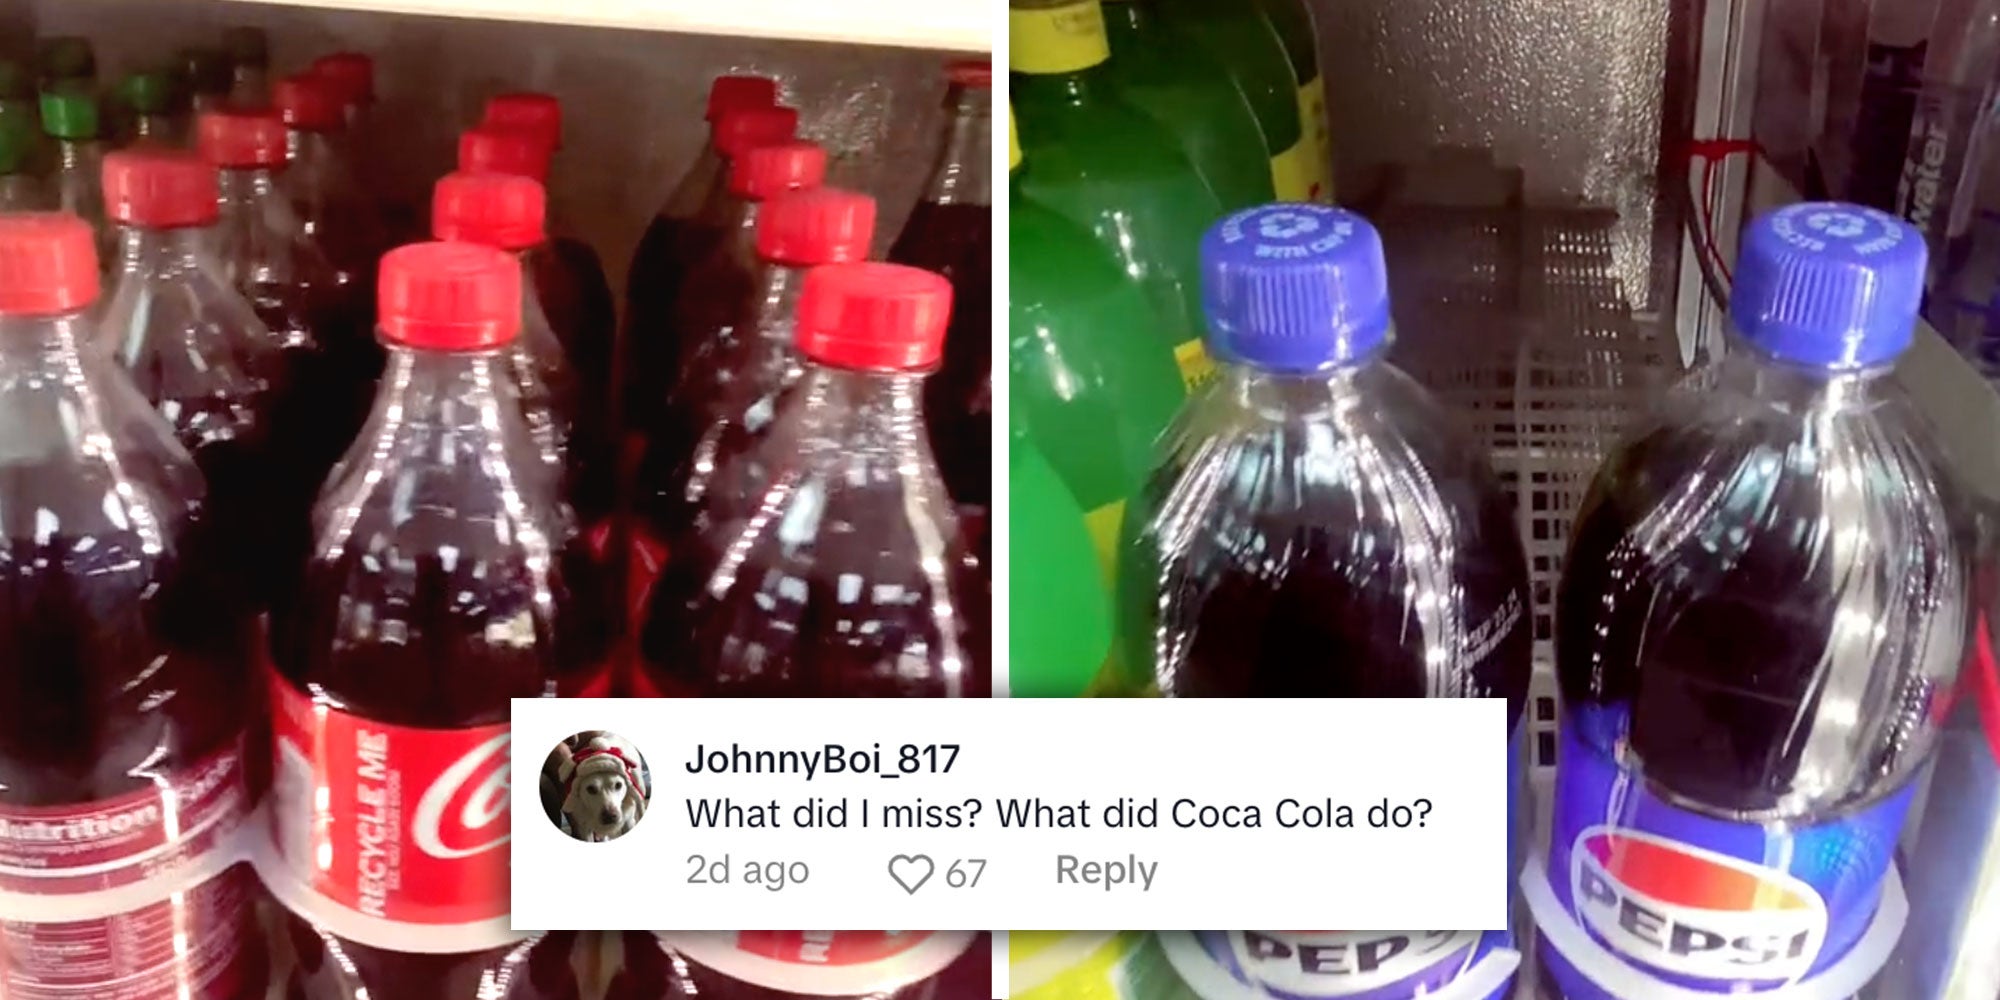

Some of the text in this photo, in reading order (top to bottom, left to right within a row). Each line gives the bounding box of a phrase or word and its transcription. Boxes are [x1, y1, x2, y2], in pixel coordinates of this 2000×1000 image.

[356, 729, 389, 918] RECYCLE ME
[1243, 930, 1459, 975] PEPS
[1579, 858, 1810, 966] PEPSI
